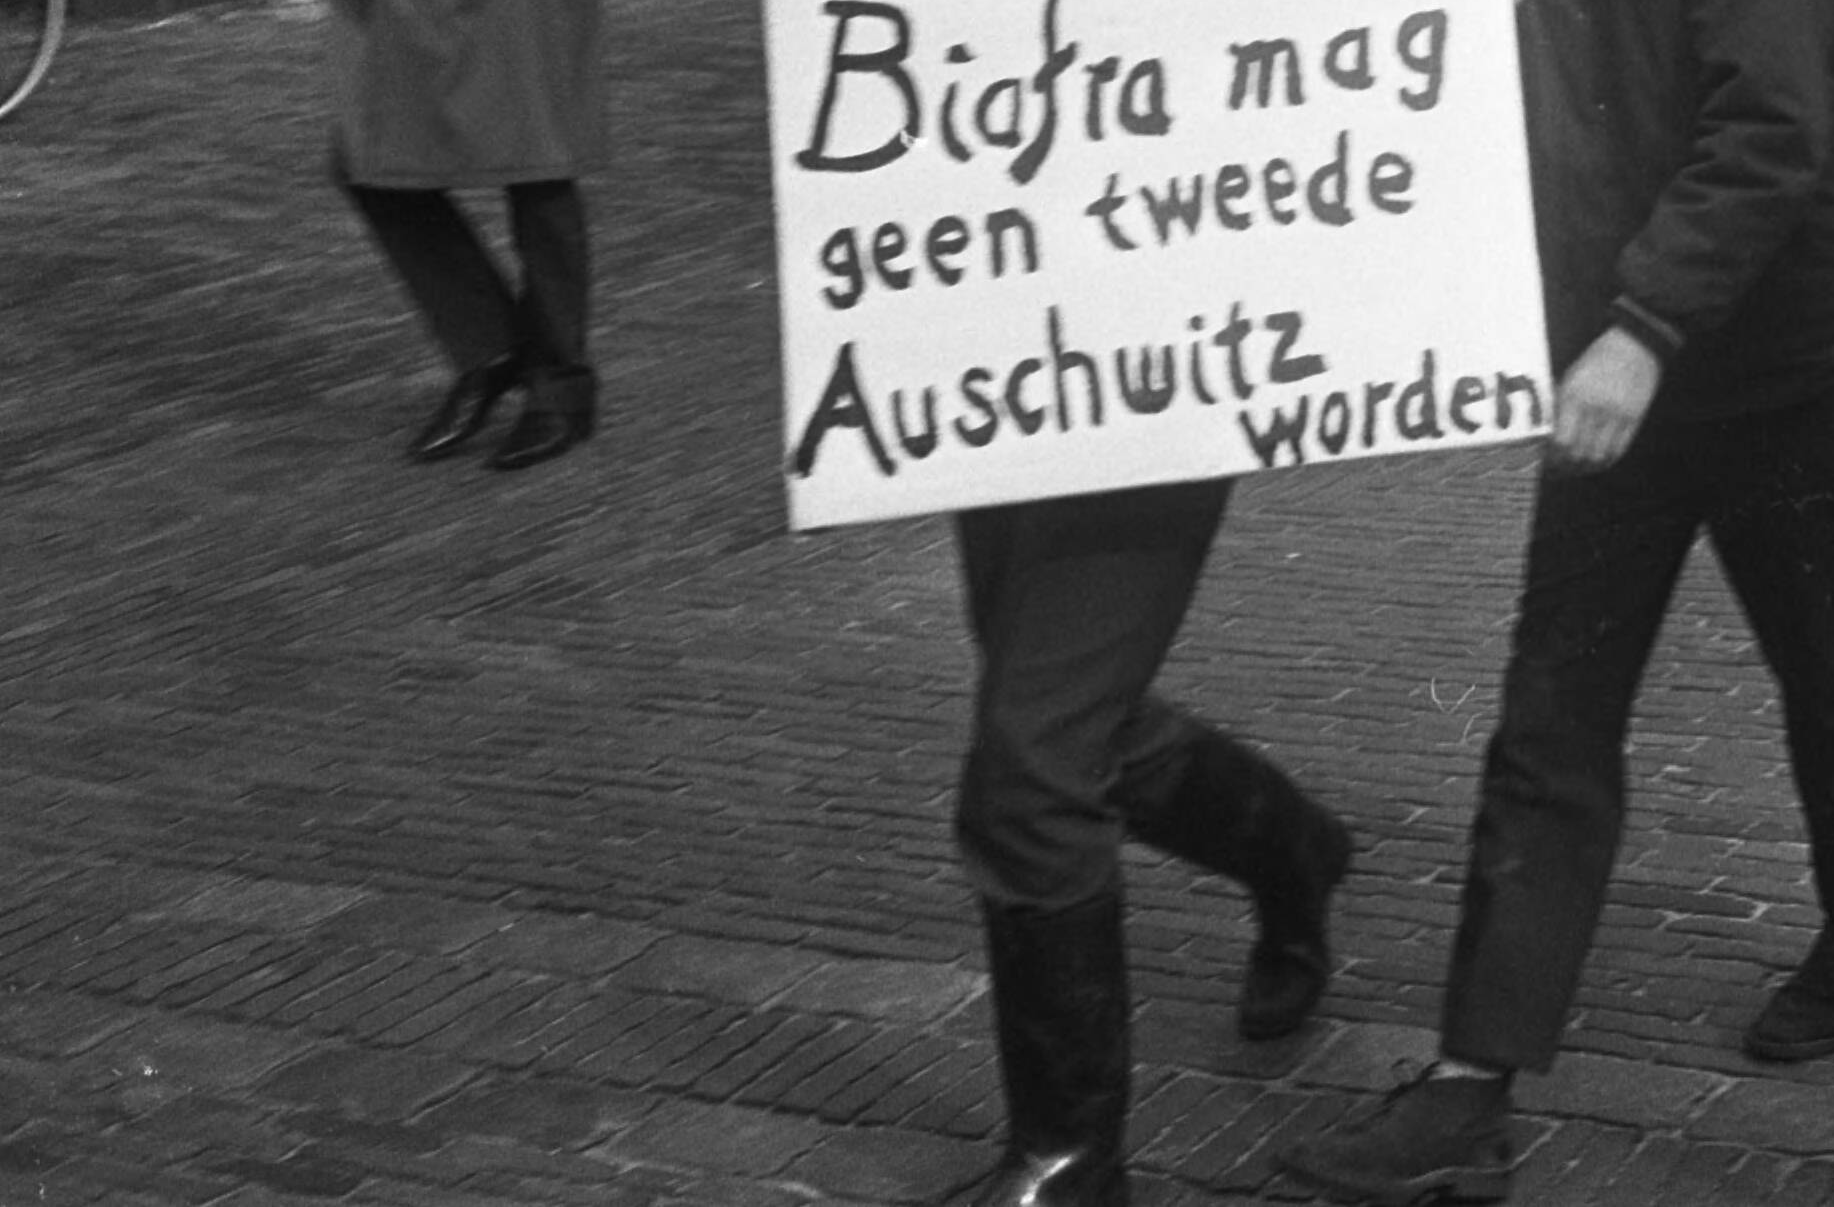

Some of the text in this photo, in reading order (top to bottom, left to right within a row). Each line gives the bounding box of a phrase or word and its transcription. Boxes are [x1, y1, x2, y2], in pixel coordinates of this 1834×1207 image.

[1227, 8, 1449, 112] mag
[819, 130, 1417, 311] geen tweede
[791, 300, 1328, 480] Auschwitz
[1238, 347, 1544, 469] worden
